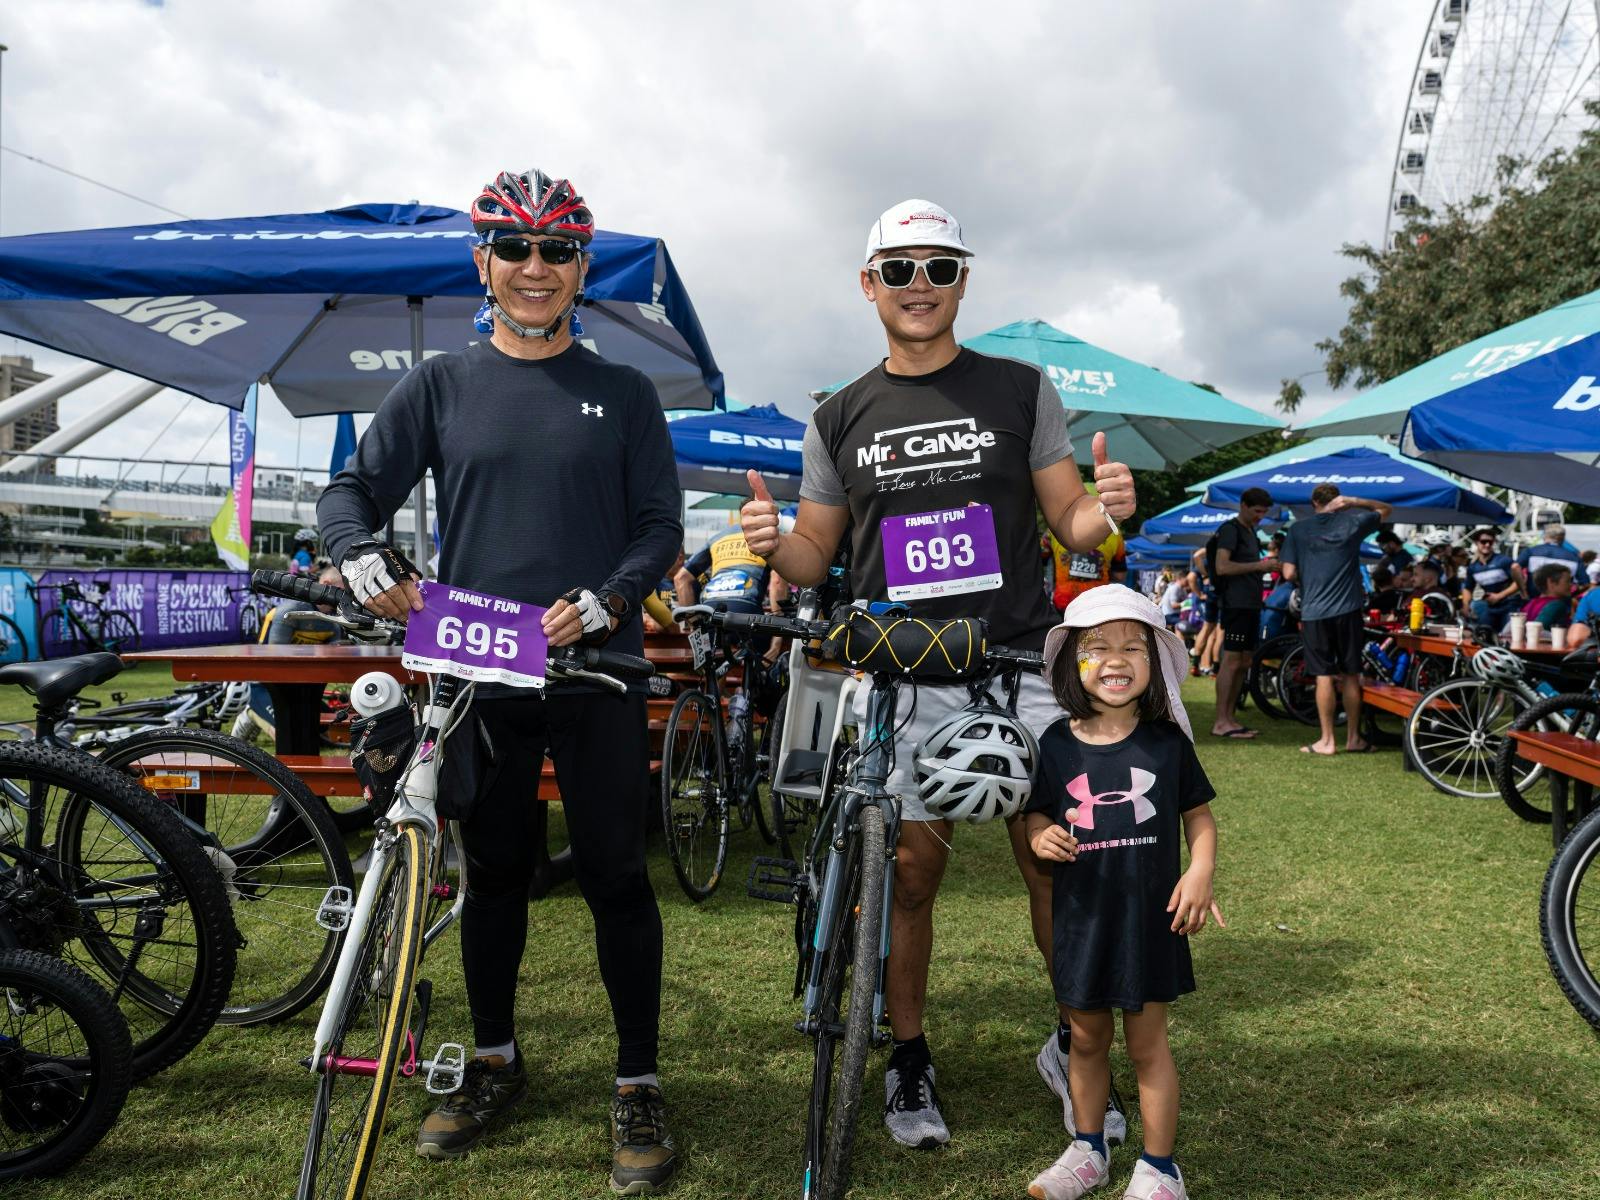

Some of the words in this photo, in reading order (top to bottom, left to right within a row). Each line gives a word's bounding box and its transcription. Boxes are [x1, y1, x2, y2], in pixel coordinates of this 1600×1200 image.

[857, 443, 896, 468] Mr.
[904, 431, 996, 458] CaNoe
[1267, 474, 1405, 484] brisbane
[905, 514, 940, 528] FAMILY
[943, 509, 966, 524] FUN
[905, 533, 975, 573] 693
[1070, 560, 1097, 573] 3228
[448, 589, 492, 609] FAMILY
[493, 599, 521, 614] FUN
[436, 616, 519, 660] 695
